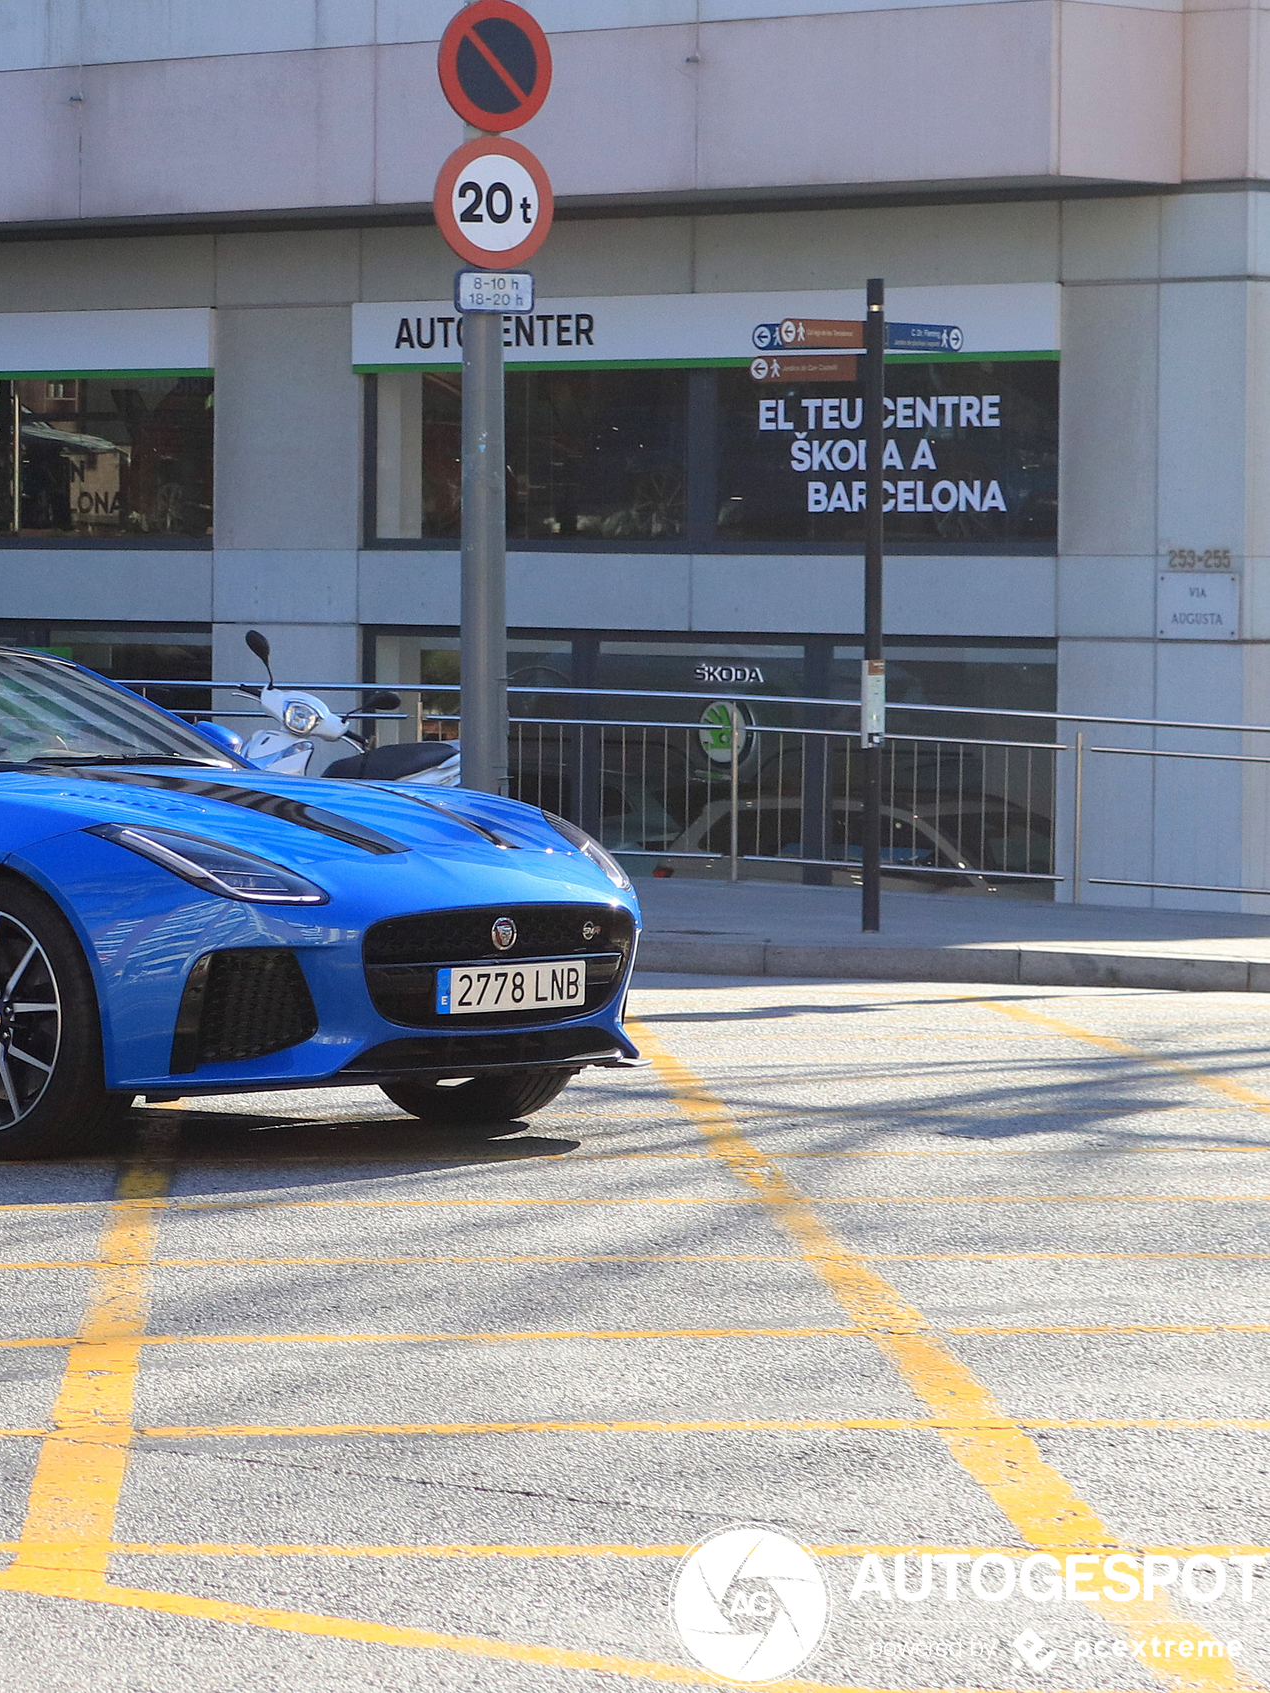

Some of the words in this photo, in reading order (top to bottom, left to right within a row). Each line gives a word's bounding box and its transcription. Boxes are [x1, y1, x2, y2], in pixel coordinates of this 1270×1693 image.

[458, 181, 513, 224] 20
[520, 196, 532, 224] t
[473, 277, 506, 291] 8-10
[511, 278, 519, 290] h
[468, 293, 511, 306] 18-20
[515, 294, 524, 306] h
[395, 313, 595, 349] AUTENTER
[759, 399, 794, 431] EL
[801, 398, 864, 430] TEU
[910, 439, 937, 471] A
[1169, 549, 1231, 568] 253-255
[1189, 586, 1207, 598] VIA
[1171, 612, 1223, 625] AUGUSTA
[695, 663, 764, 683] ŠKODA
[441, 995, 448, 1005] E
[457, 971, 525, 1007] 2778
[534, 967, 580, 1002] LNB
